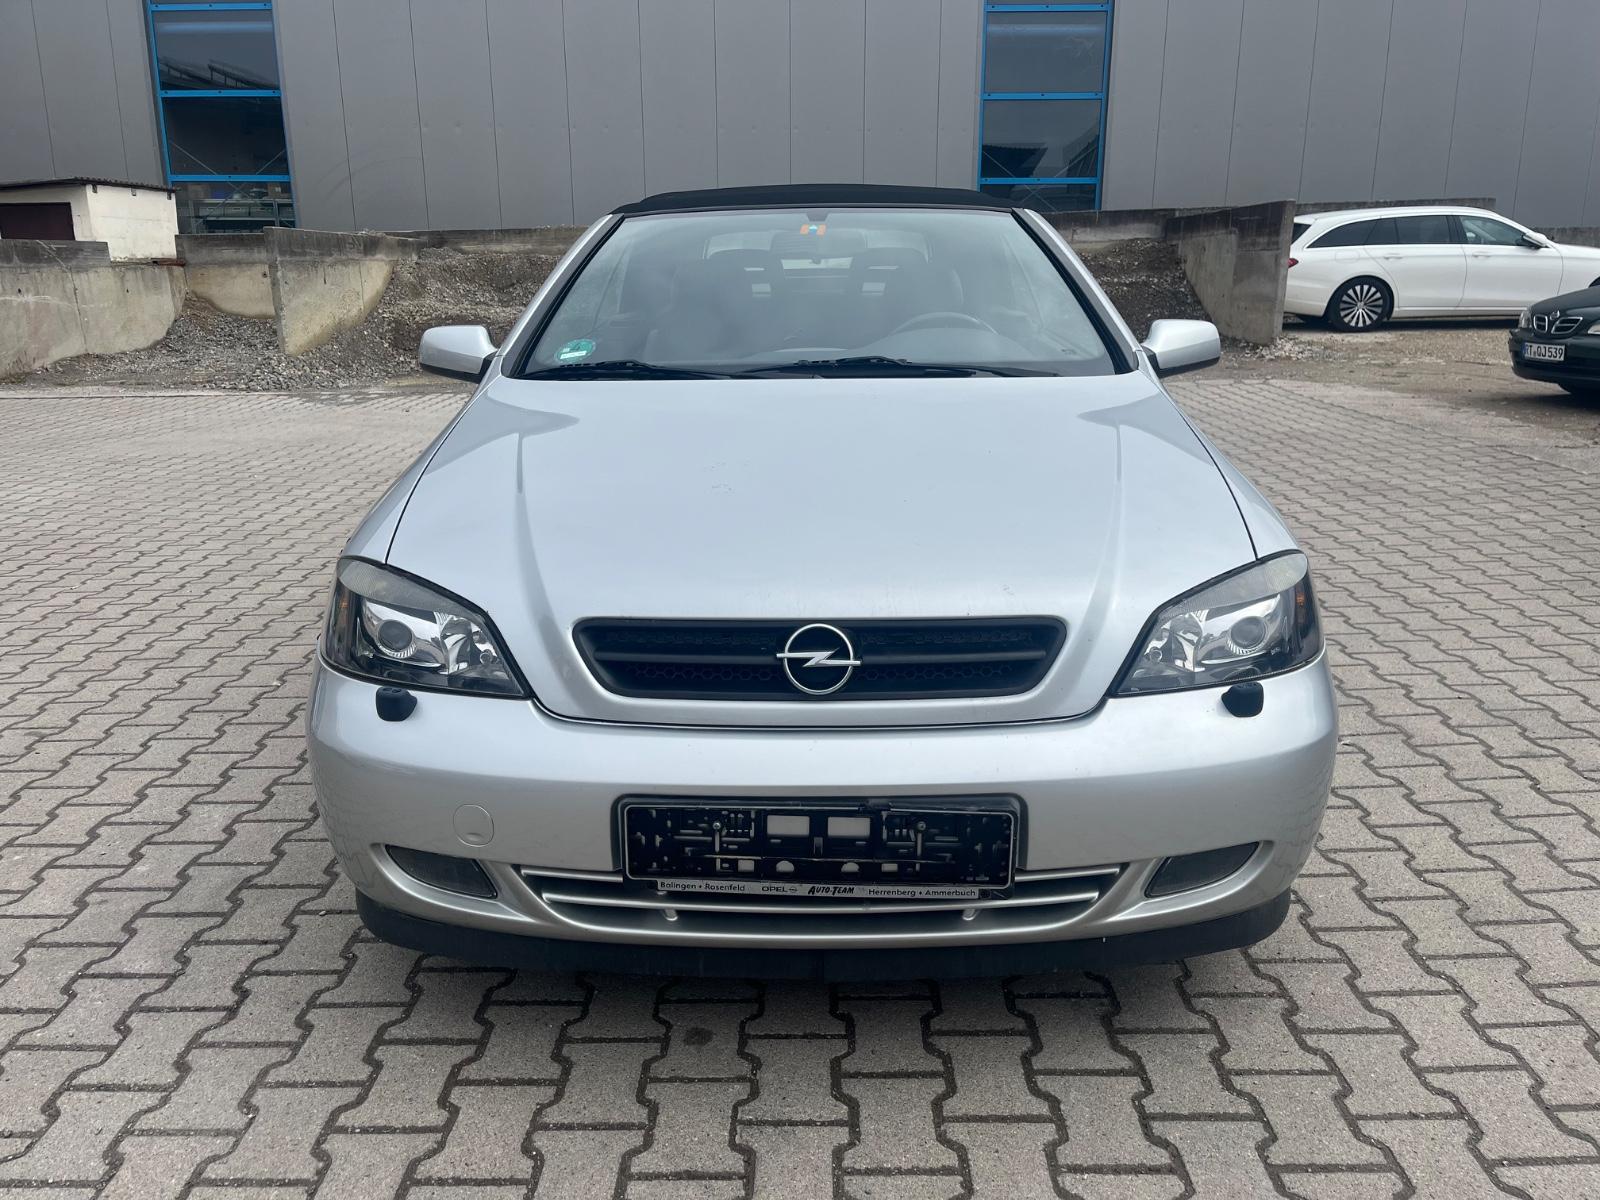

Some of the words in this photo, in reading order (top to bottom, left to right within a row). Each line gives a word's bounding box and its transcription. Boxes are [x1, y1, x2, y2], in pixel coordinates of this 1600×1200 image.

[660, 882, 697, 890] Balingen
[705, 883, 745, 892] Rosenfeld
[868, 888, 916, 897] Herrenberg
[925, 888, 976, 896] Ammerbuch
